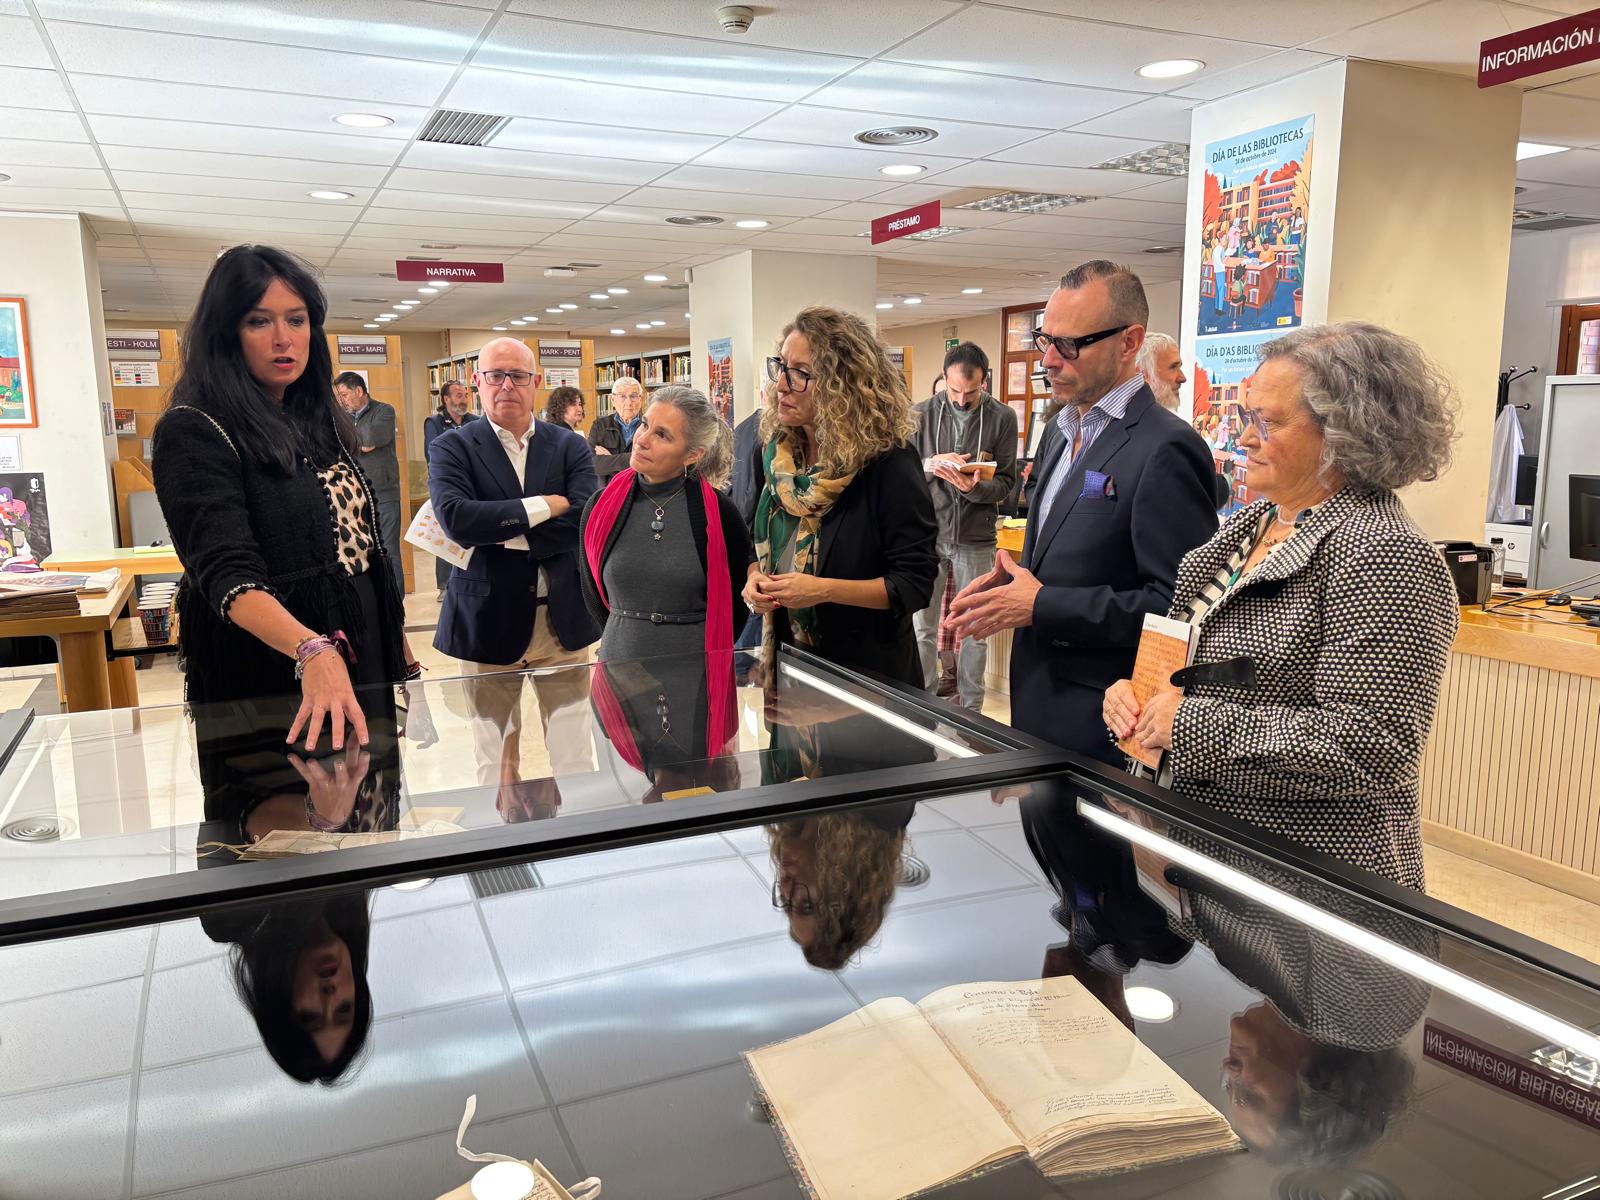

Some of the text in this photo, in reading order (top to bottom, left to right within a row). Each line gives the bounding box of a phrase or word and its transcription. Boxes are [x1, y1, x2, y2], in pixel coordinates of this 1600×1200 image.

[1482, 27, 1594, 72] INFORMACIÓN
[1212, 128, 1304, 163] DÍA DE LAS BIBLIOTECAS
[888, 214, 920, 232] PRÉSTAMO
[426, 267, 477, 277] NARRATIVA
[540, 348, 560, 356] MARK
[1206, 345, 1219, 358] DÍA
[1220, 346, 1235, 356] D'AS
